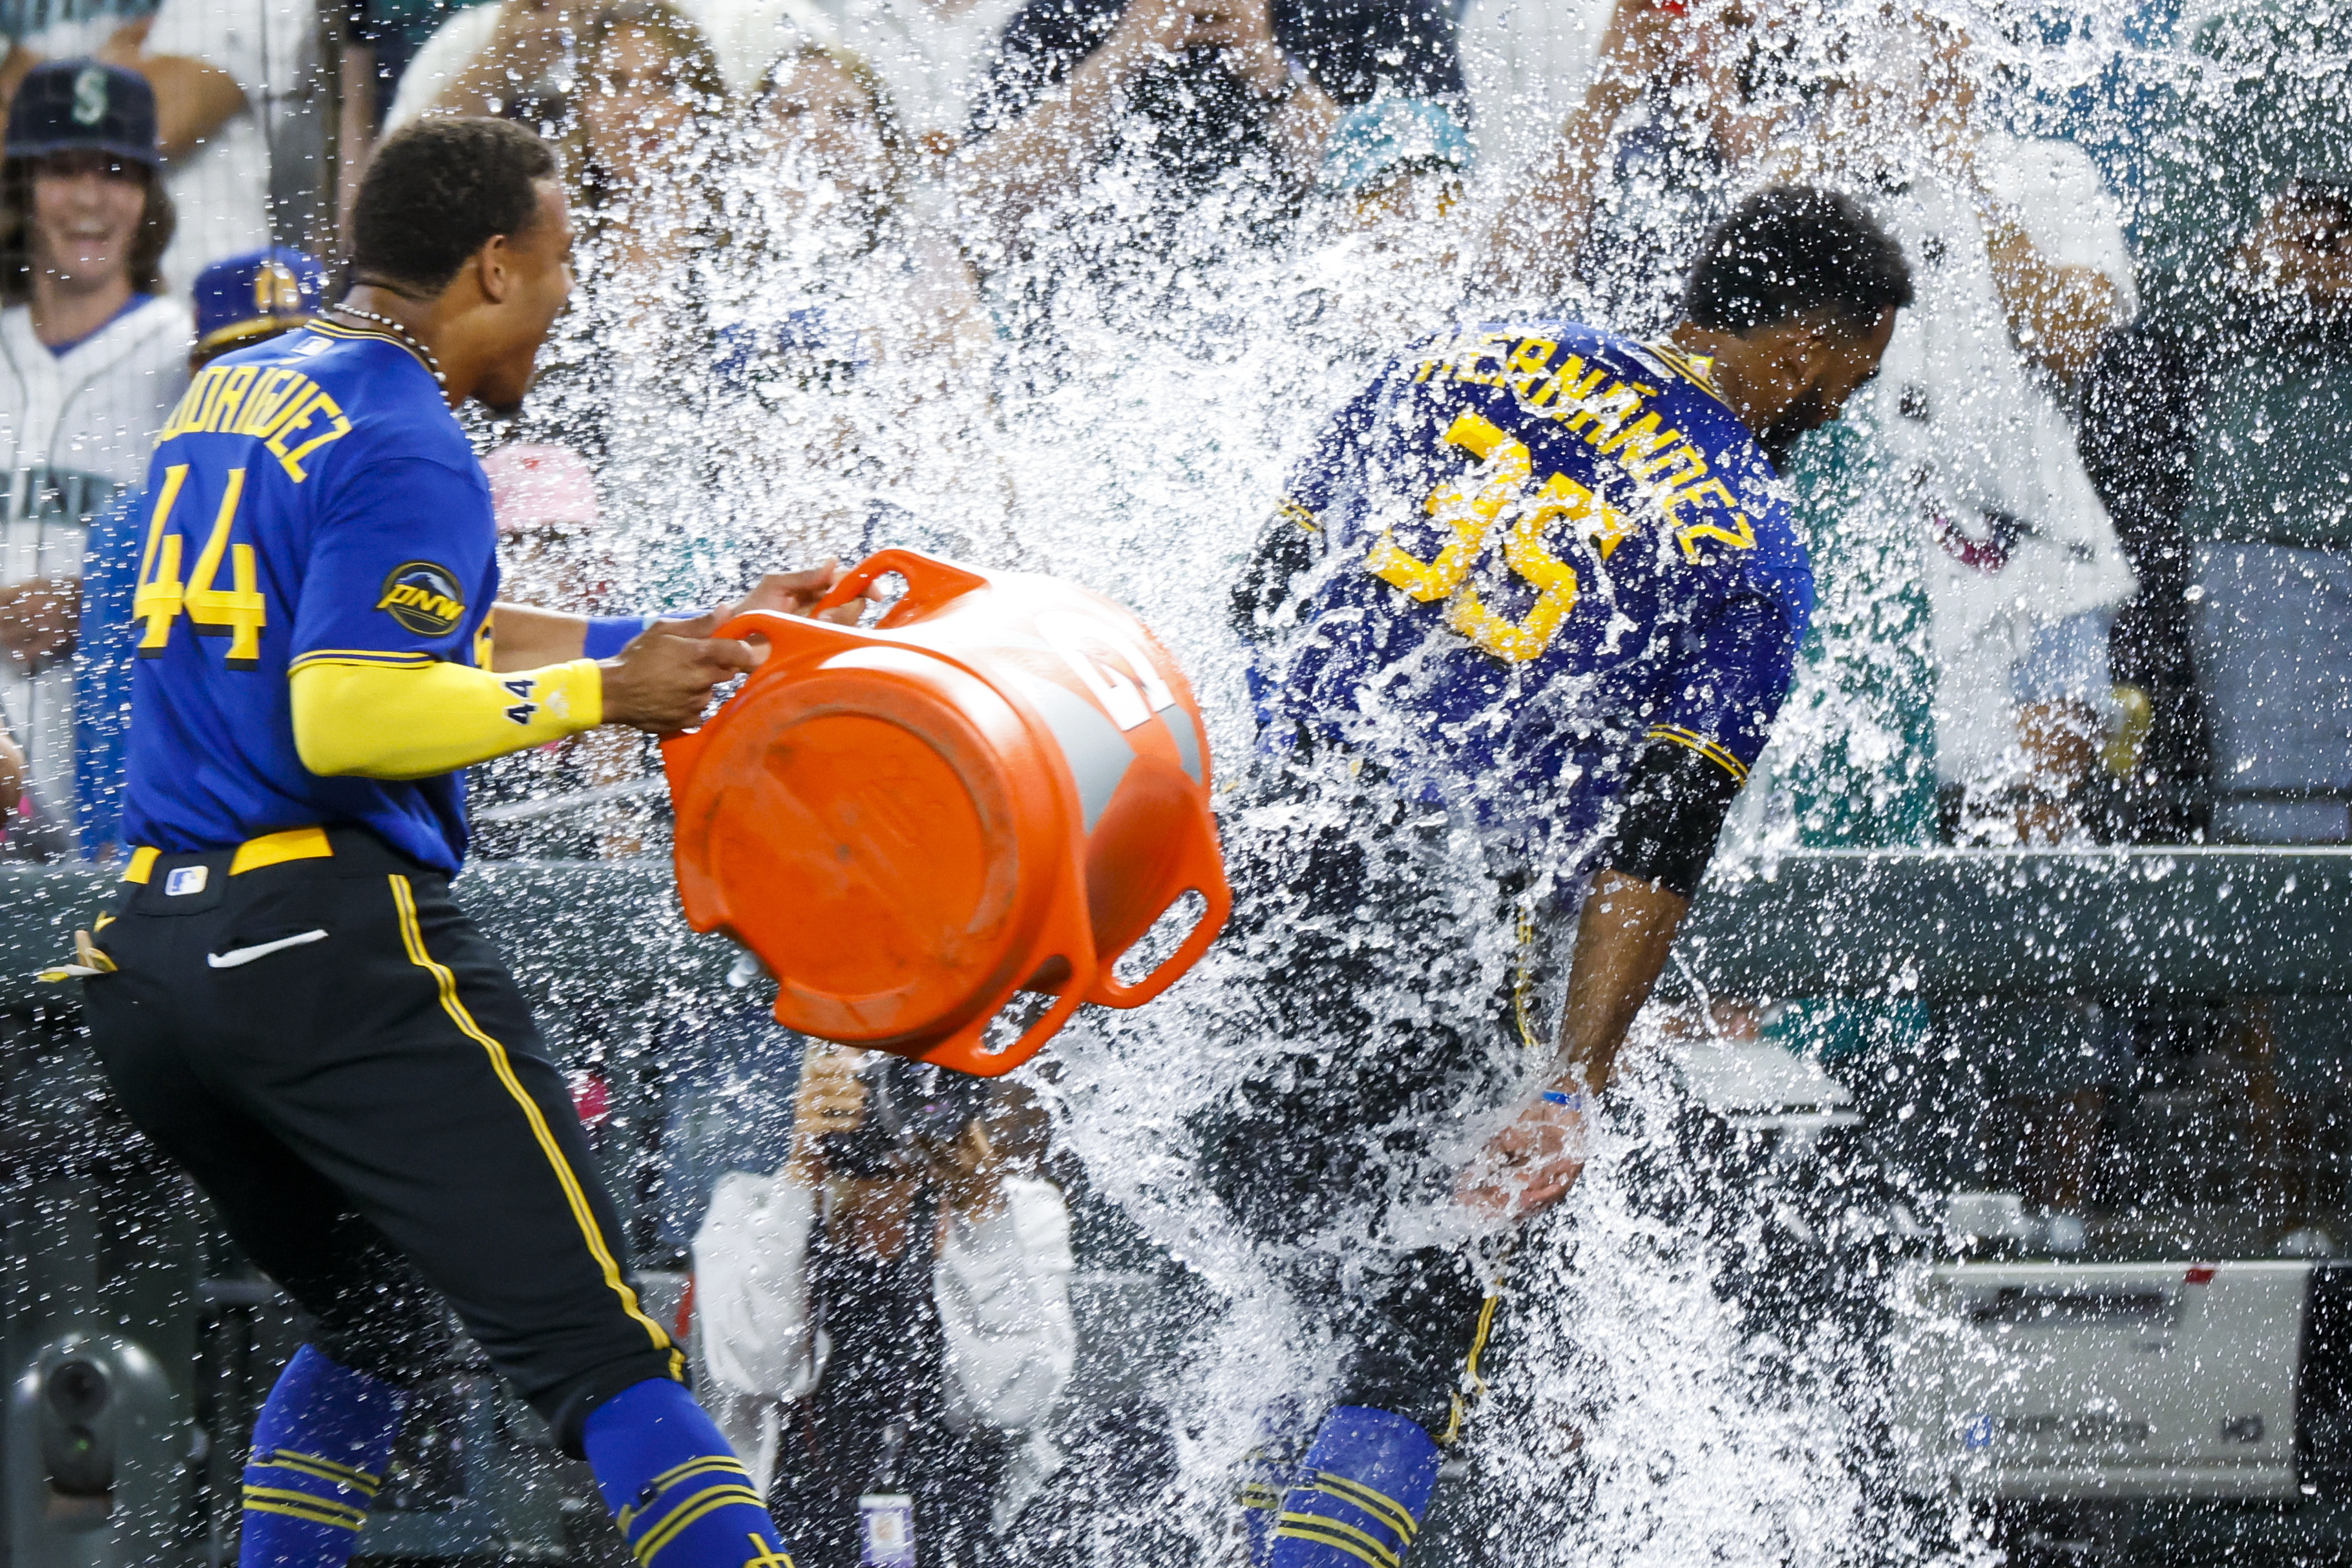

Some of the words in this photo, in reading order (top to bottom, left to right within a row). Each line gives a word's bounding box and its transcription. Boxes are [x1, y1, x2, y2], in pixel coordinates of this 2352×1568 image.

[152, 356, 353, 483] ODRÍGUEZ
[132, 463, 266, 670] 44
[1363, 408, 1639, 664] 35
[498, 678, 540, 726] 44
